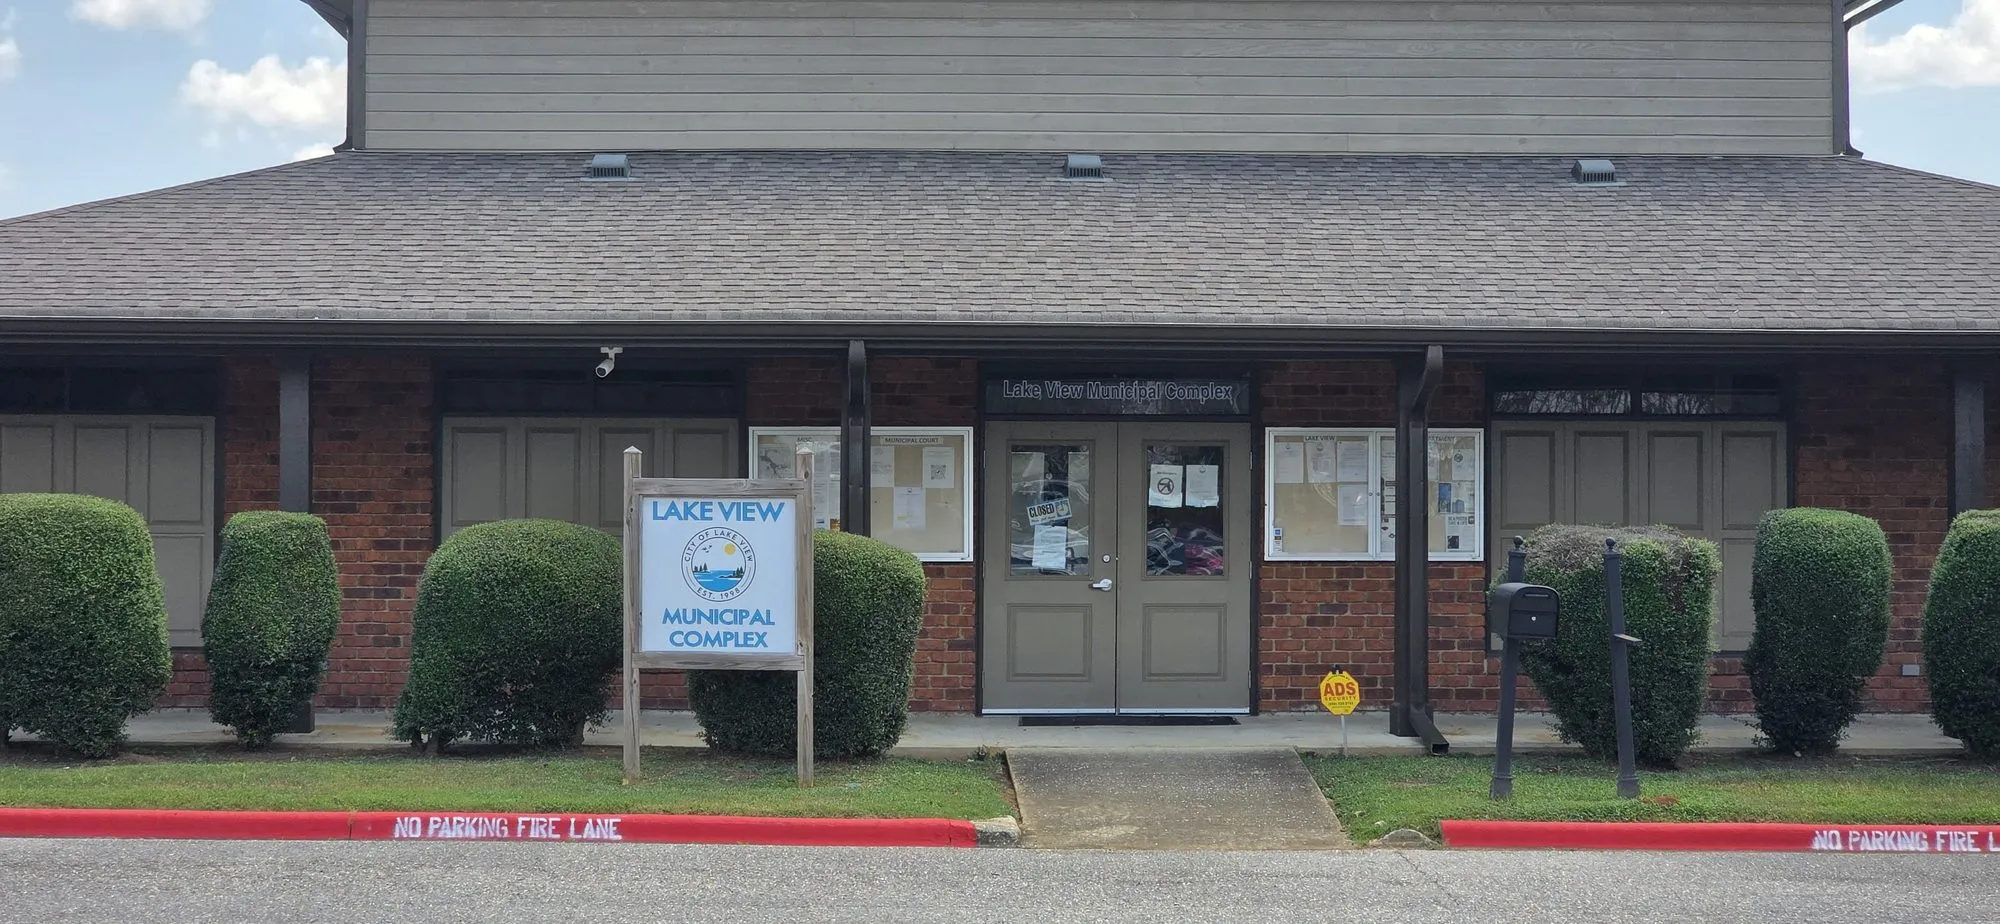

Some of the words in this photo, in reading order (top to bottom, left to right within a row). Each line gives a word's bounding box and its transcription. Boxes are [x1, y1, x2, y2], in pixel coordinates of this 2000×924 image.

[1003, 380, 1041, 398] Lake
[1045, 380, 1084, 399] View
[1087, 381, 1161, 403] Municipal
[1164, 382, 1233, 404] Complex
[652, 501, 713, 521] LAKE
[717, 501, 785, 522] VIEW
[1028, 503, 1055, 518] CLOSED
[684, 541, 697, 562] CITY
[698, 530, 709, 541] OF
[714, 529, 738, 541] LAKE
[739, 539, 753, 562] VIEW
[697, 586, 716, 600] EST.
[720, 587, 741, 600] 1998
[662, 607, 776, 626] MUNICIPAL
[669, 630, 769, 648] COMPLEX
[1323, 682, 1356, 697] ADS
[394, 816, 422, 839] NO
[427, 816, 509, 839] PARKING
[516, 817, 561, 839] FIRE
[569, 817, 623, 840] LANE
[1812, 829, 1842, 851] NO
[1848, 830, 1929, 851] PARKING
[1936, 831, 1982, 852] FIRE
